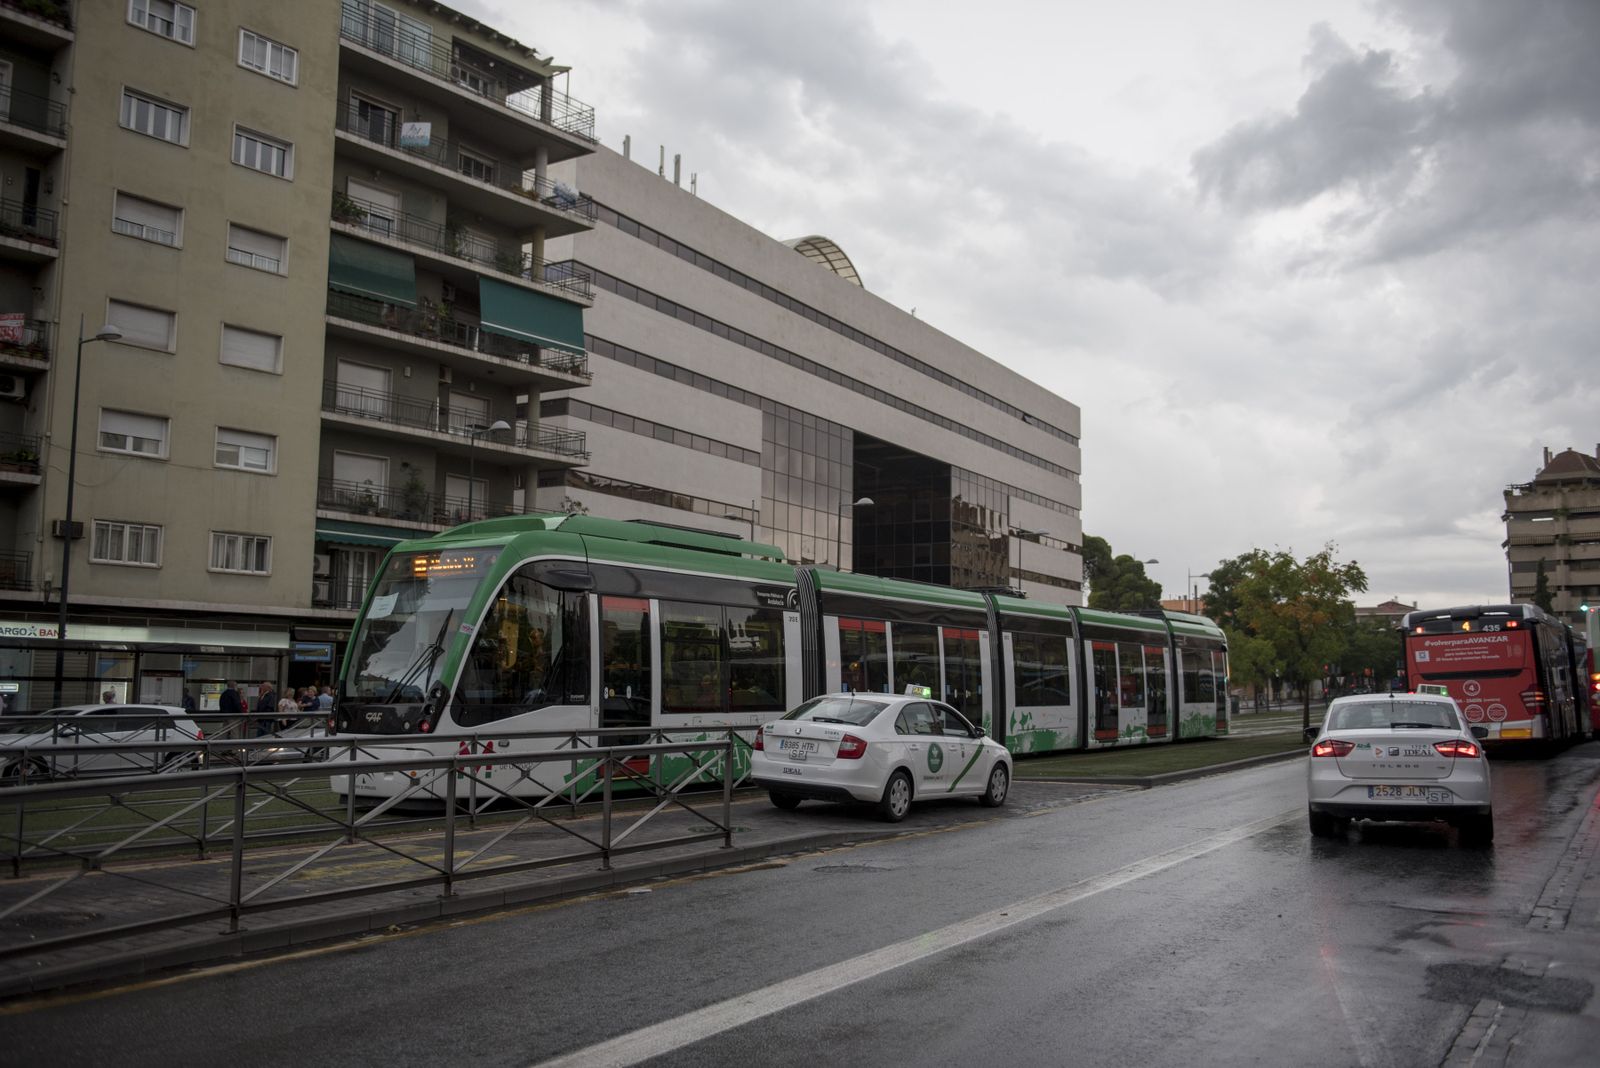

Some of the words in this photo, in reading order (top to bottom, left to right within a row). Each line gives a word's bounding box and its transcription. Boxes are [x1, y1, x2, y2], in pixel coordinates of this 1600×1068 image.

[1461, 621, 1471, 631] 4
[1482, 624, 1500, 632] 435
[1404, 749, 1434, 757] IDEAL
[783, 767, 802, 775] IDEAL
[1376, 786, 1402, 797] 2528
[1406, 786, 1426, 797] JLN
[1430, 792, 1450, 802] SP
